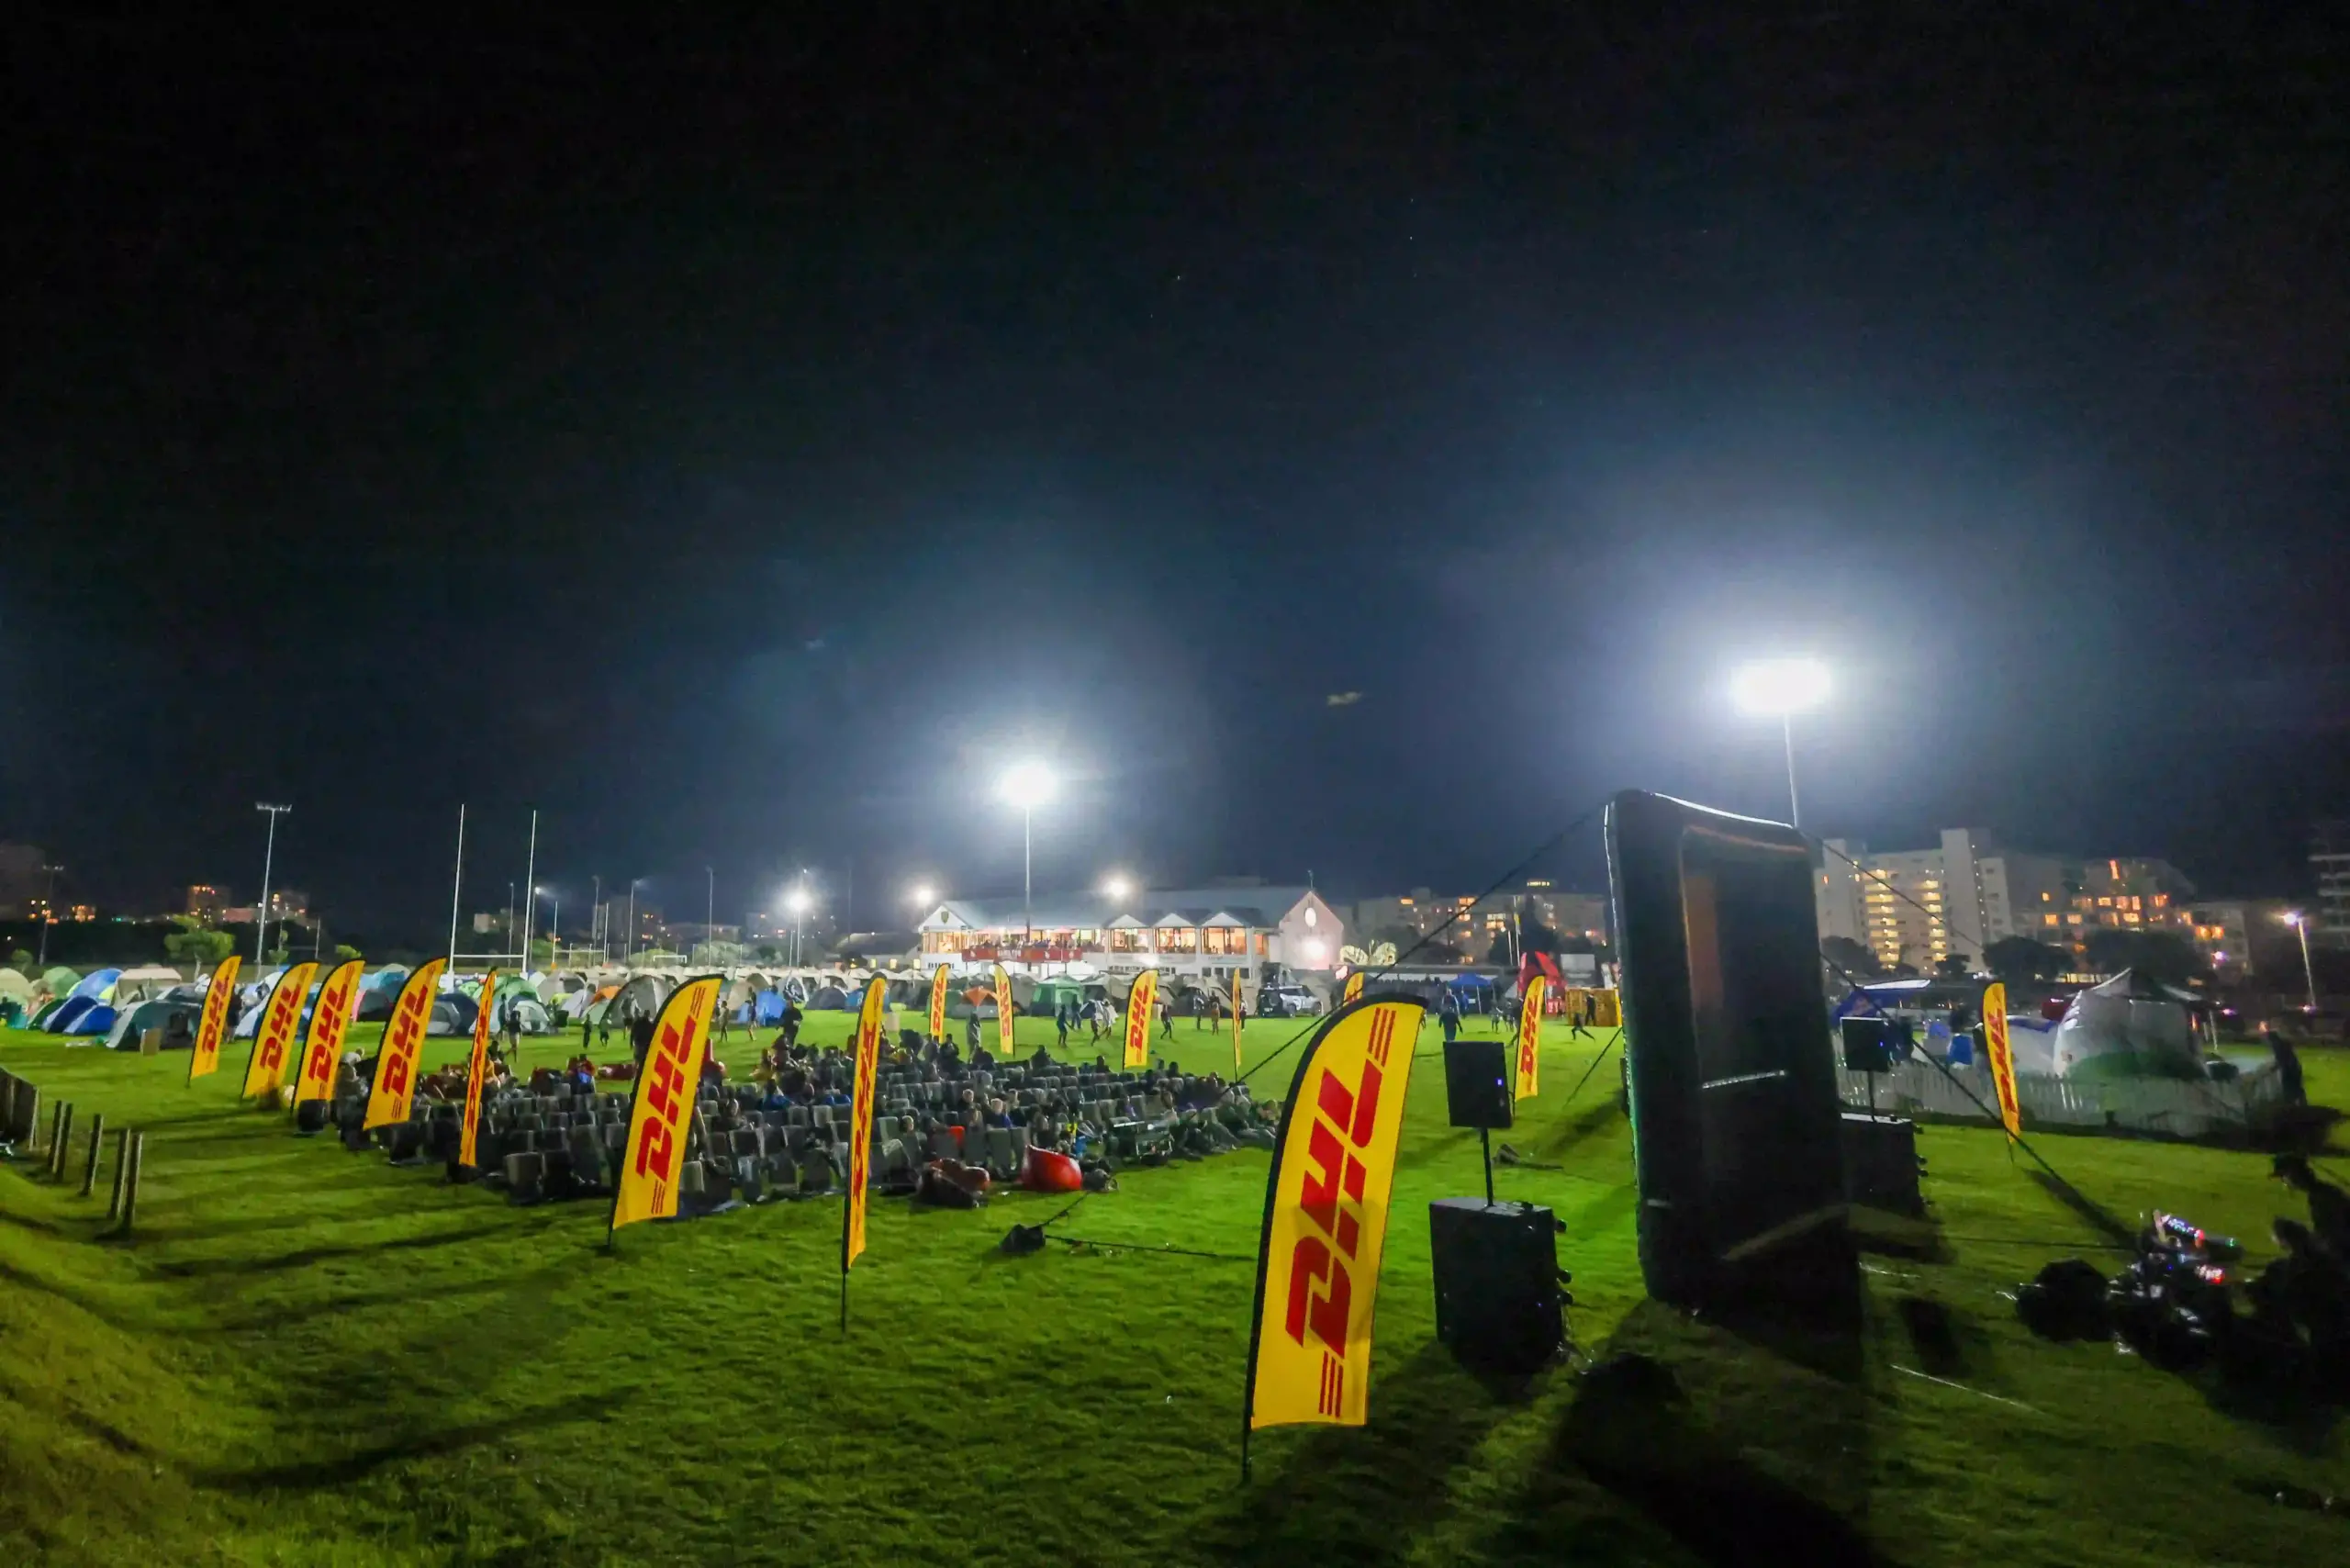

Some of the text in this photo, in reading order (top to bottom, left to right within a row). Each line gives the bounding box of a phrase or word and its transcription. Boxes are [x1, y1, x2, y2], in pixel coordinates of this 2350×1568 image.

[202, 974, 229, 1053] DHL
[259, 983, 301, 1071] DHL
[308, 983, 348, 1083] DHL
[382, 984, 429, 1097] DHL
[1130, 984, 1149, 1050] DHL
[1520, 994, 1539, 1075] DHL
[635, 1014, 697, 1182] DHL
[1285, 1058, 1382, 1360] DHL
